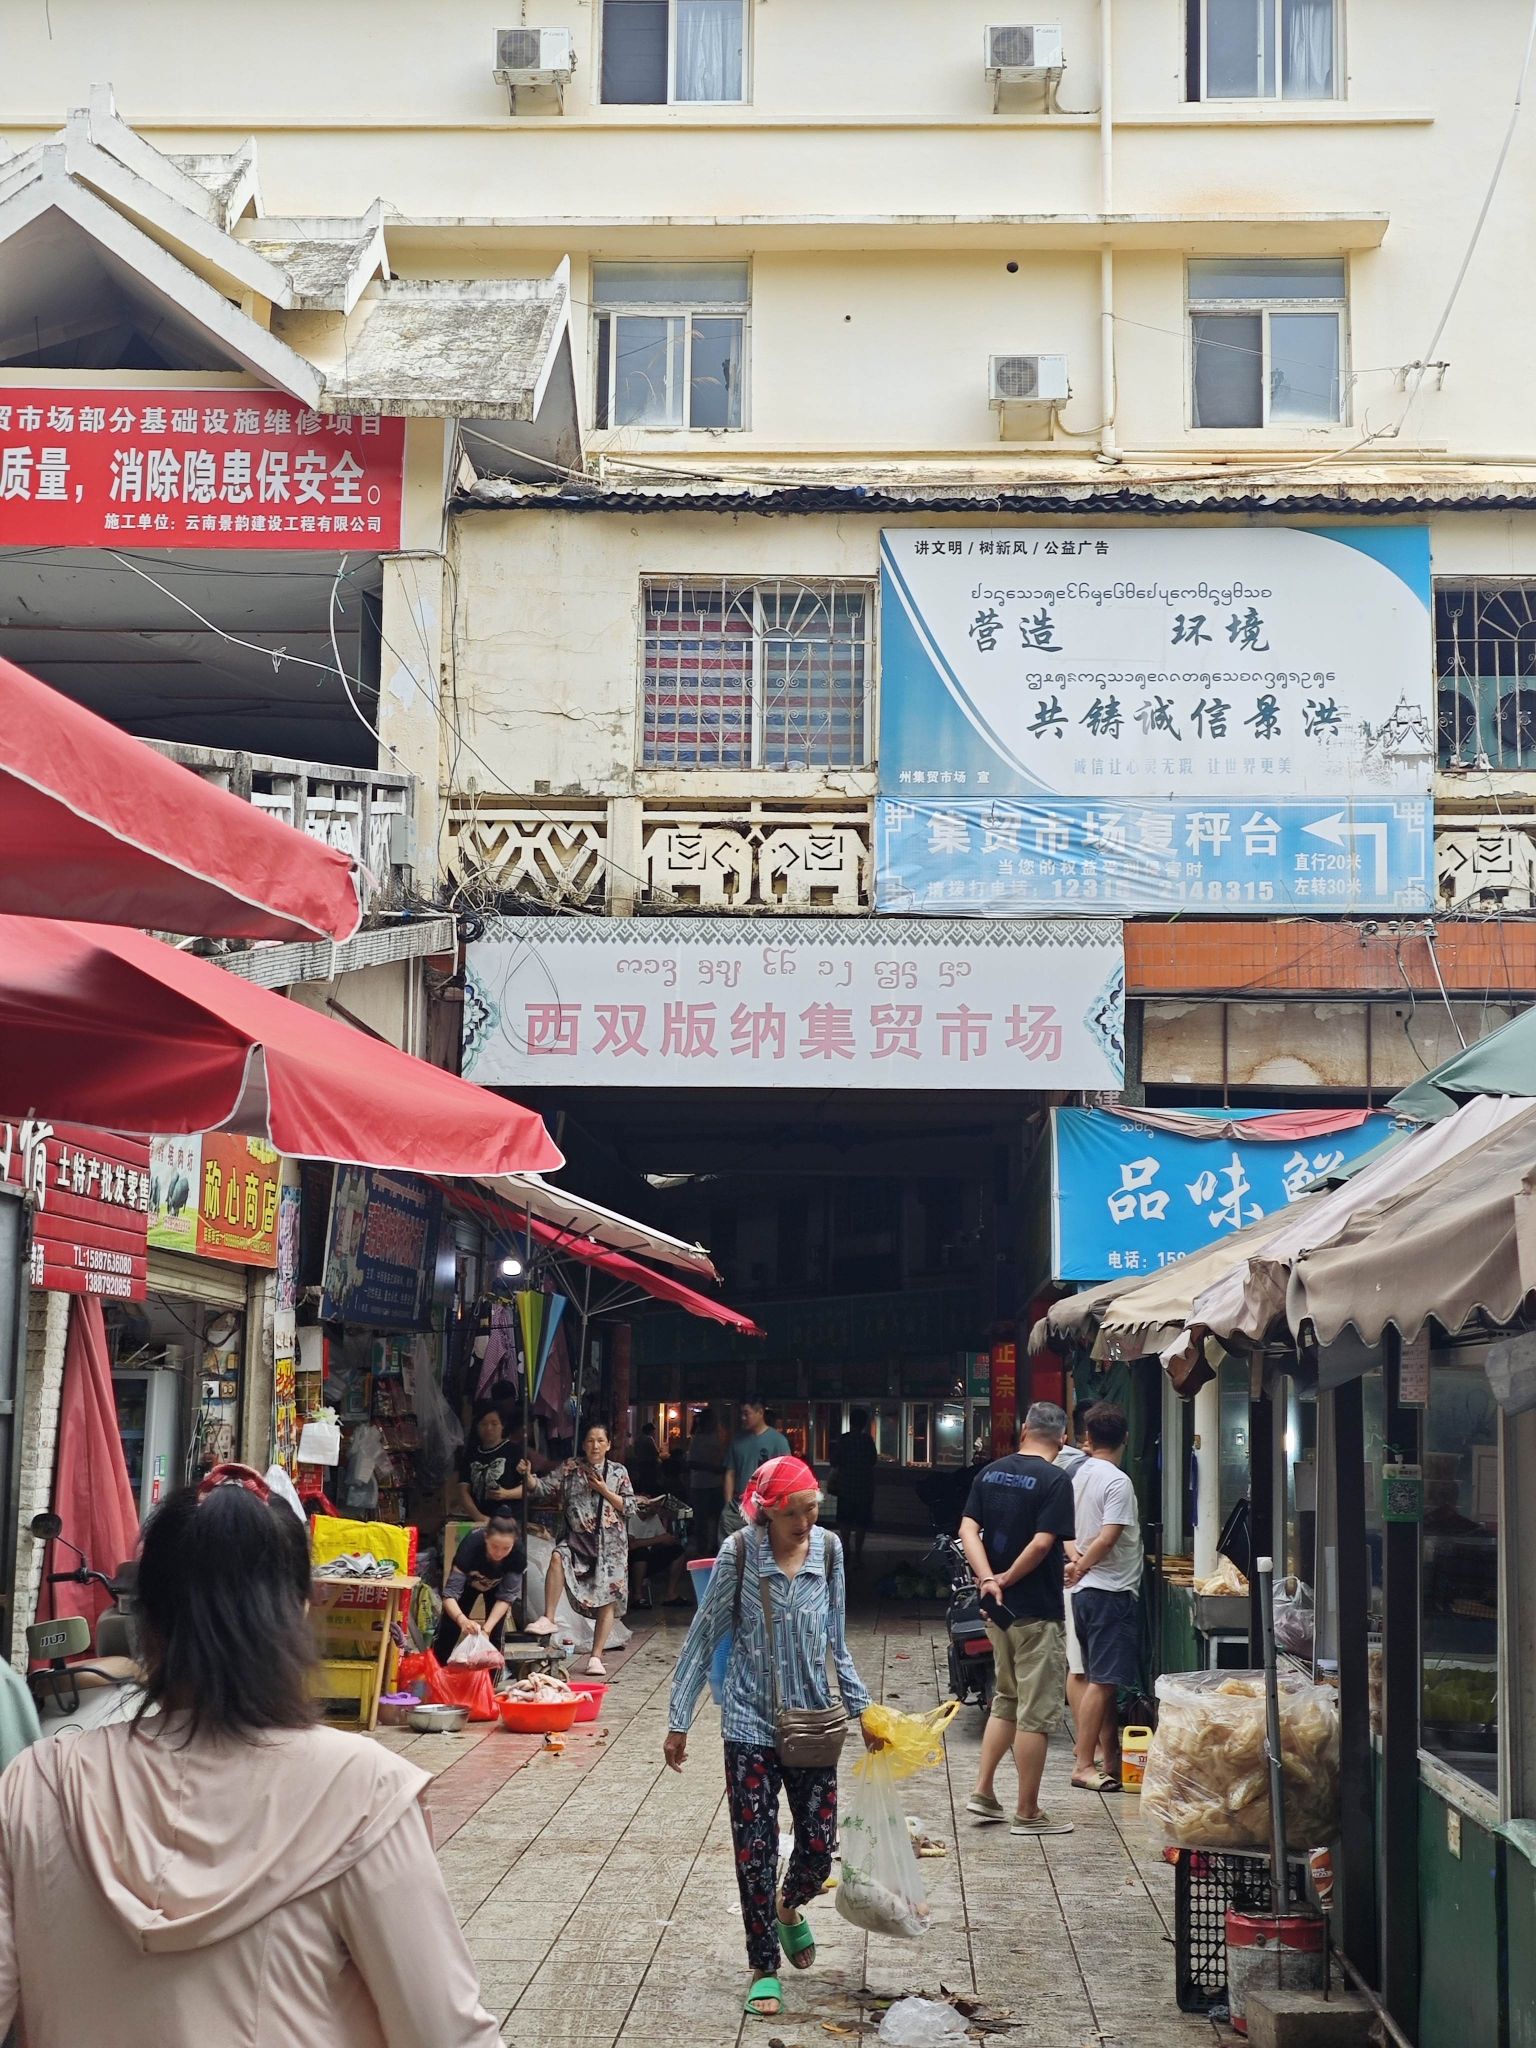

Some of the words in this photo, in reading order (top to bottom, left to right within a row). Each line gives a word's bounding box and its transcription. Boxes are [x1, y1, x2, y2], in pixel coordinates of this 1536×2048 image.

[969, 607, 1063, 653] 营造
[1171, 606, 1270, 652] 环境
[1026, 694, 1343, 741] 共铸诚信景洪
[1208, 757, 1292, 775] 让世界更美
[926, 810, 1283, 858] 集贸市场复秤台
[1294, 852, 1362, 873] 直行20米
[1294, 876, 1362, 897] 左转30米
[524, 1001, 1064, 1063] 西双版纳集贸市场
